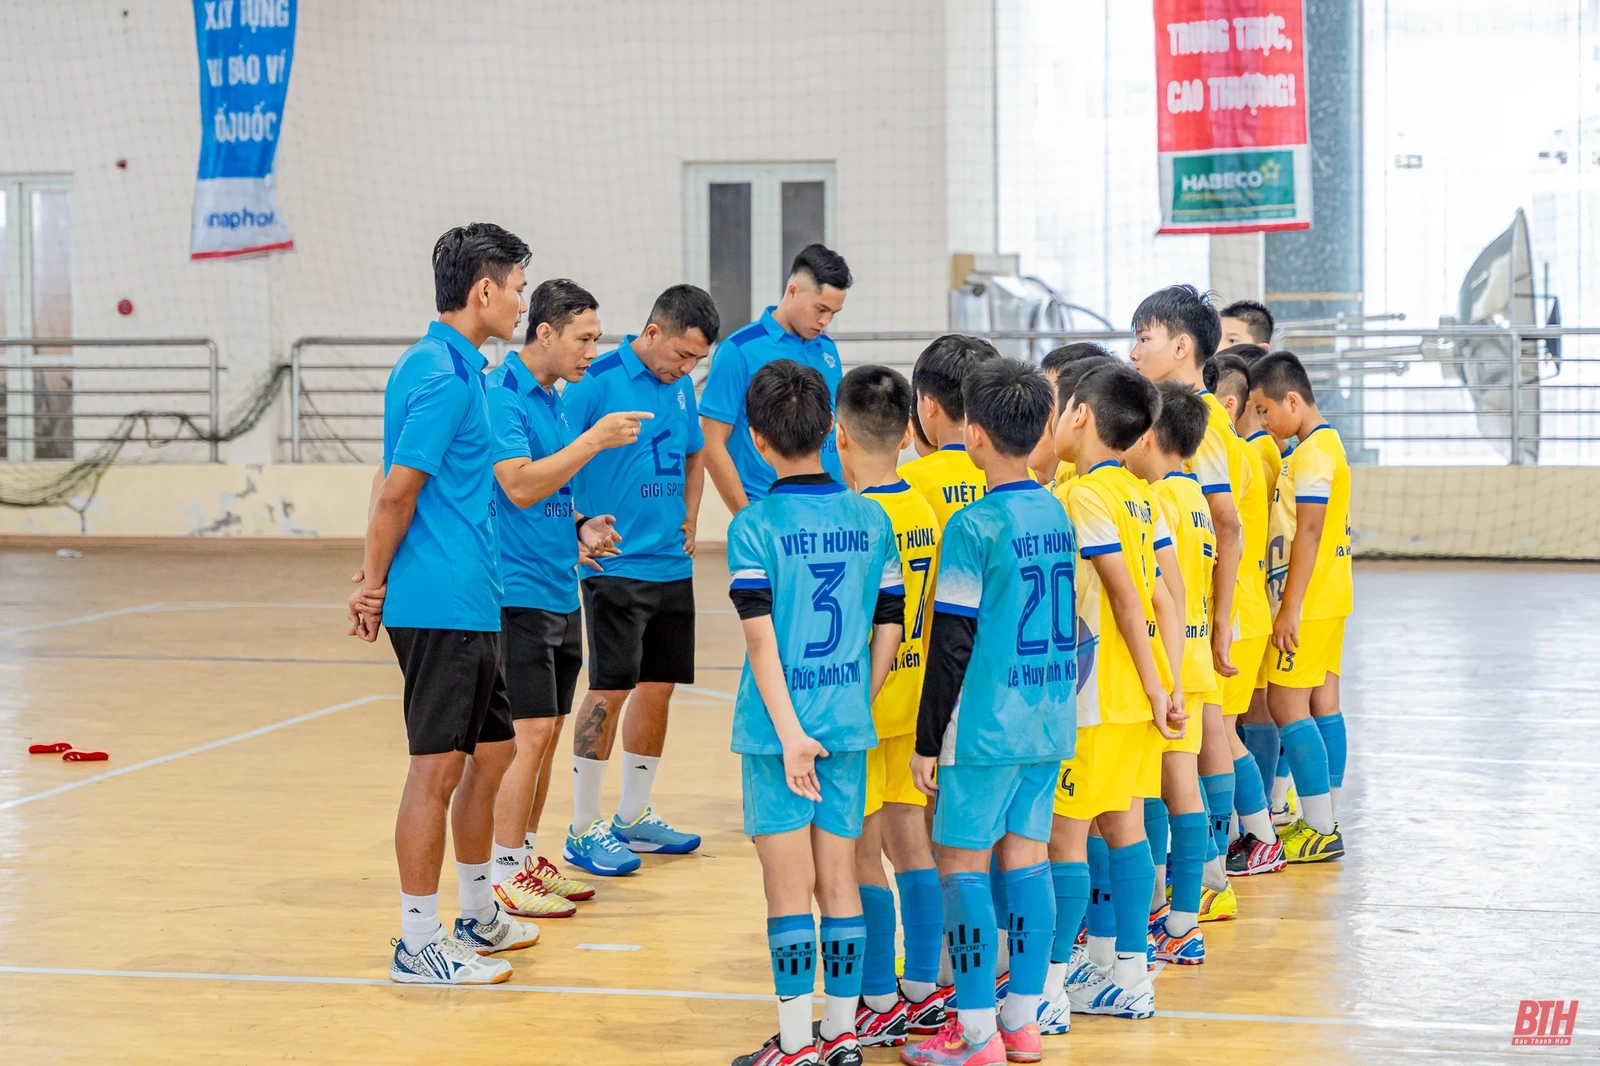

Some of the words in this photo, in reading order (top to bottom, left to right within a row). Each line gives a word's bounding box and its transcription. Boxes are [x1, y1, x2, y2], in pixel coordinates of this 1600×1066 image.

[1167, 19, 1229, 56] TRUNG
[1233, 13, 1292, 56] THỰC,
[1167, 78, 1204, 114] CAO
[1207, 72, 1296, 116] THƯỢNG!
[1181, 171, 1263, 191] HABECO
[640, 482, 663, 499] GIGI
[780, 528, 818, 559] VIỆT
[822, 527, 869, 554] HÙNG
[906, 525, 936, 549] HÙNG
[1011, 532, 1040, 561] VIỆT
[803, 561, 846, 659] 3
[1016, 562, 1077, 656] 20
[1276, 651, 1296, 672] 13
[792, 666, 815, 691] Đức
[1061, 768, 1075, 797] 4
